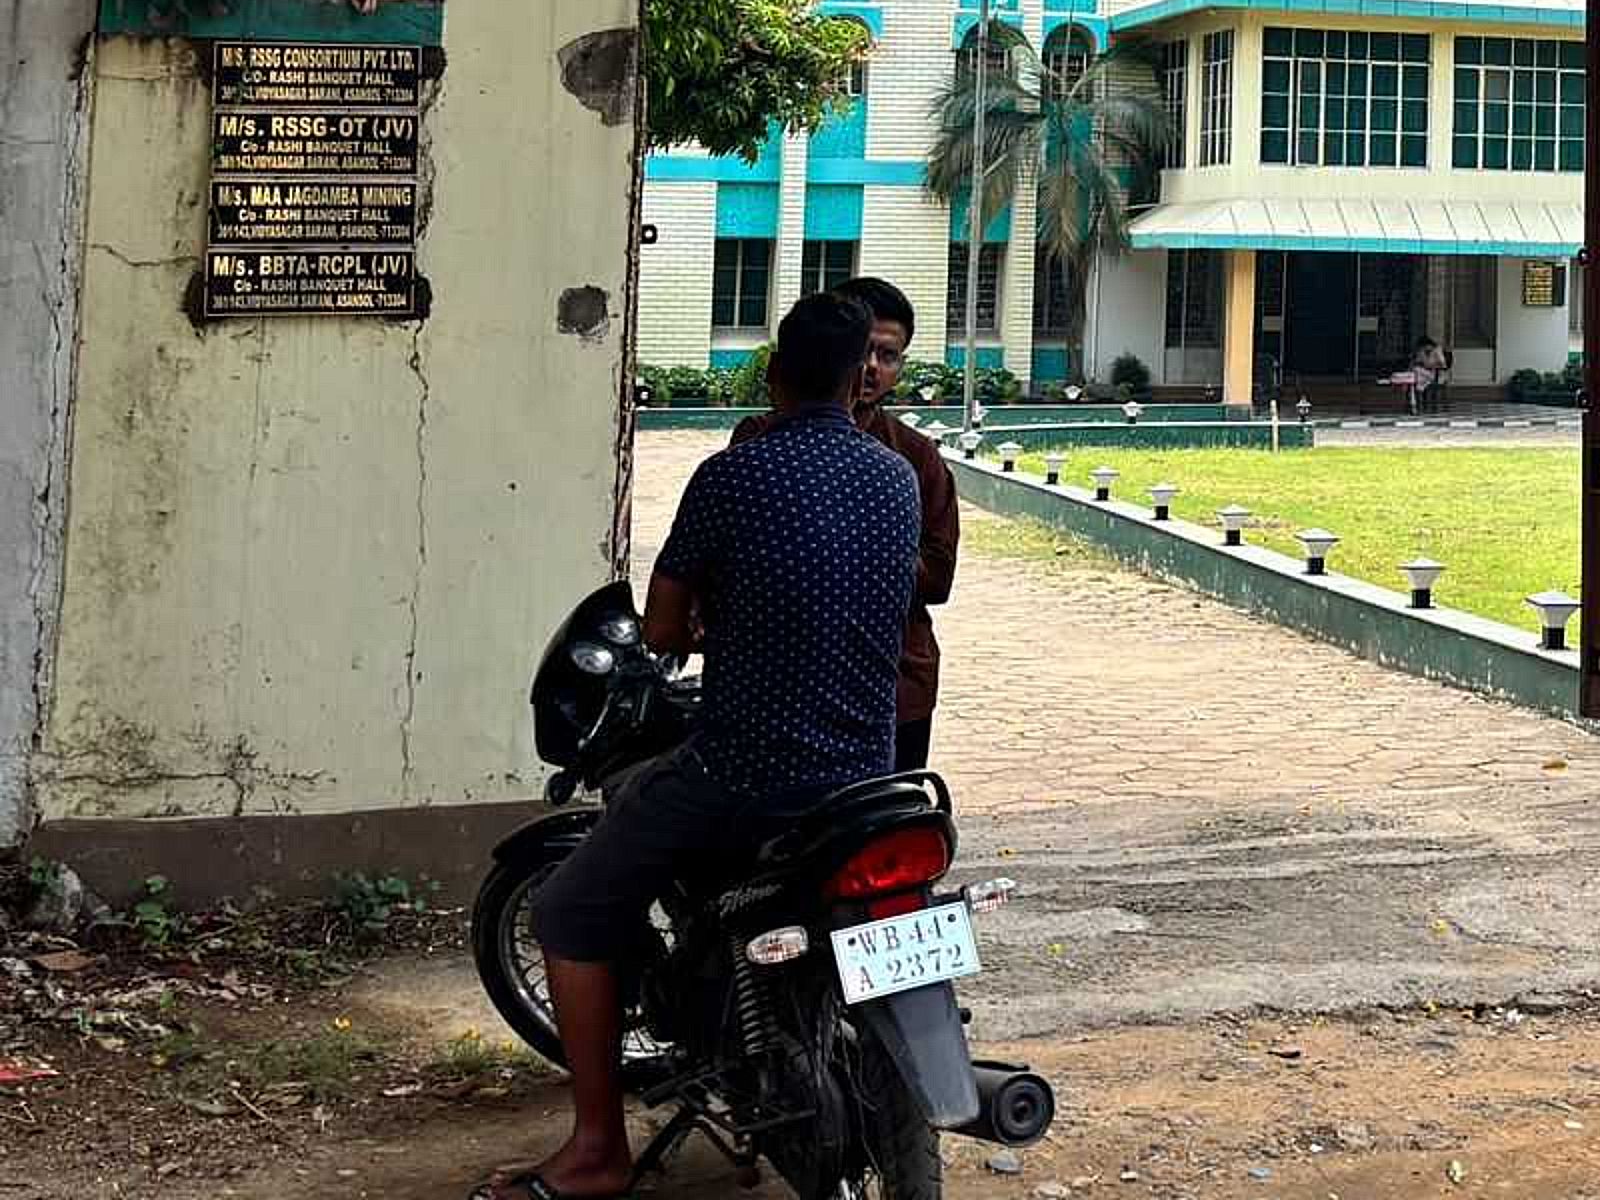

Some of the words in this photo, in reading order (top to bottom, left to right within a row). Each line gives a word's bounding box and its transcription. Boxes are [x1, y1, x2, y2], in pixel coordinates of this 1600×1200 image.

[250, 48, 280, 68] RSSG
[283, 48, 360, 69] CONSORTIUM
[391, 51, 415, 70] LTD.
[269, 71, 305, 83] RASHI
[308, 72, 362, 84] BANQUET
[365, 73, 394, 85] HALL
[220, 116, 265, 137] M/s.
[271, 117, 367, 137] RSSG-OT
[373, 118, 413, 139] (JV)
[267, 141, 303, 153] RASHI
[306, 141, 360, 153] BANQUET
[363, 142, 392, 154] HALL
[251, 186, 281, 206] MAA
[362, 187, 411, 206] MINING
[265, 209, 301, 221] RASHI
[304, 209, 360, 221] BANQUET
[362, 209, 391, 221] HALL
[213, 256, 254, 275] M/s.
[260, 256, 366, 275] BBTA-RCPL
[371, 256, 407, 276] (JV)
[261, 280, 297, 292] RASHI
[299, 280, 355, 292] BANQUET
[357, 281, 386, 292] HALL
[886, 943, 964, 984] 2372
